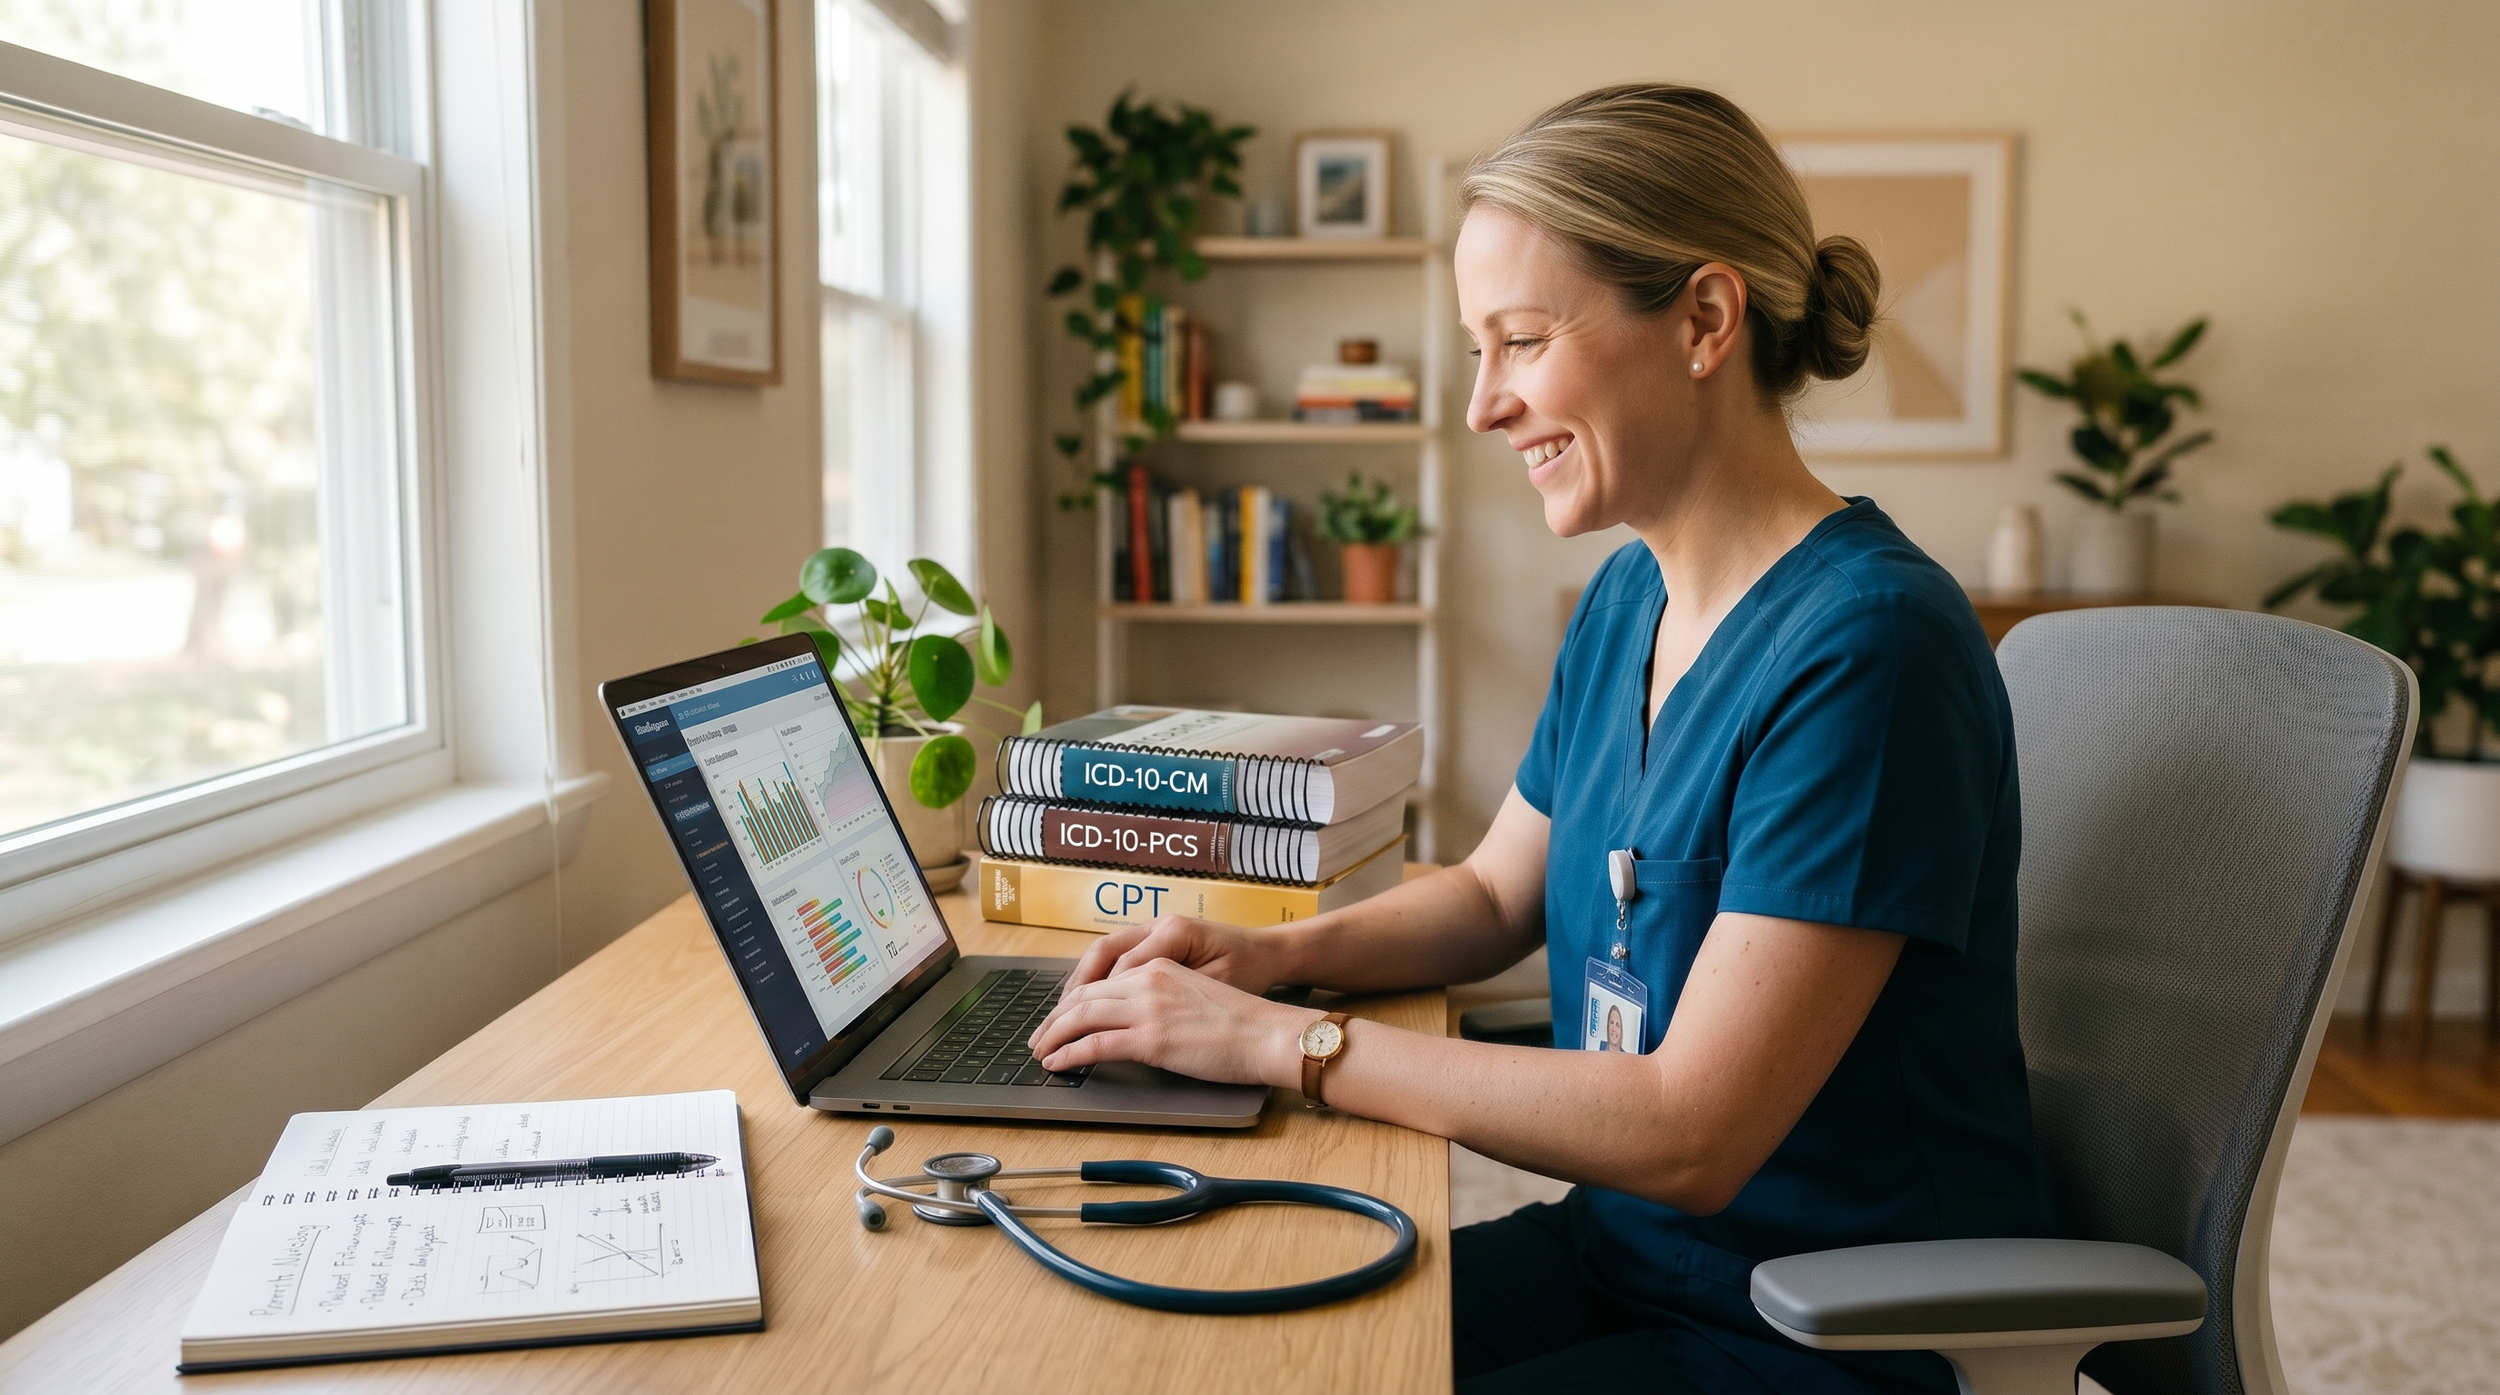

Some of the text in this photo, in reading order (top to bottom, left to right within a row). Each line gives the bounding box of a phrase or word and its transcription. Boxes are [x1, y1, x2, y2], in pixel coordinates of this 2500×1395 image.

[1084, 762, 1208, 795] ICD-10-CM
[1060, 822, 1199, 857] ICD-10-PCS
[1094, 881, 1170, 918] CPT
